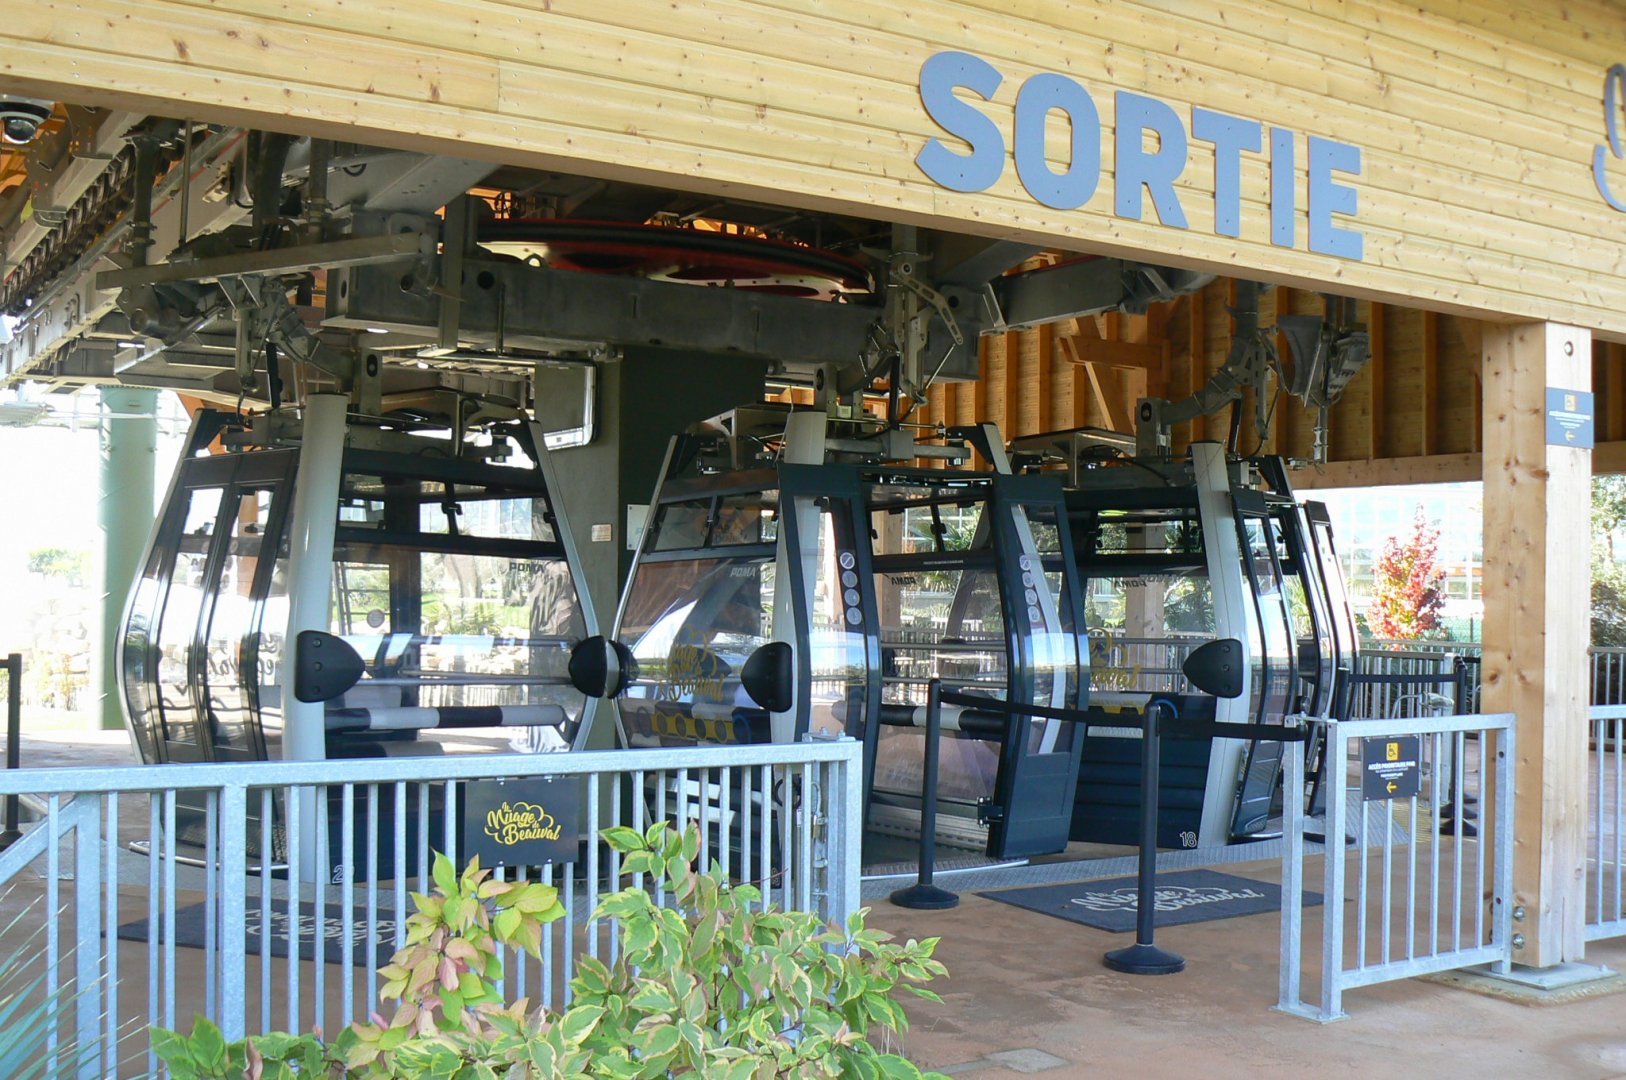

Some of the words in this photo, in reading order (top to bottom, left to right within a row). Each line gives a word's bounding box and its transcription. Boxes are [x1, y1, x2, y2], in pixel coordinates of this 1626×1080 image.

[915, 51, 1363, 261] SORTIE
[487, 808, 536, 828] Nuage
[502, 823, 562, 845] Beauval
[1179, 831, 1198, 848] 18
